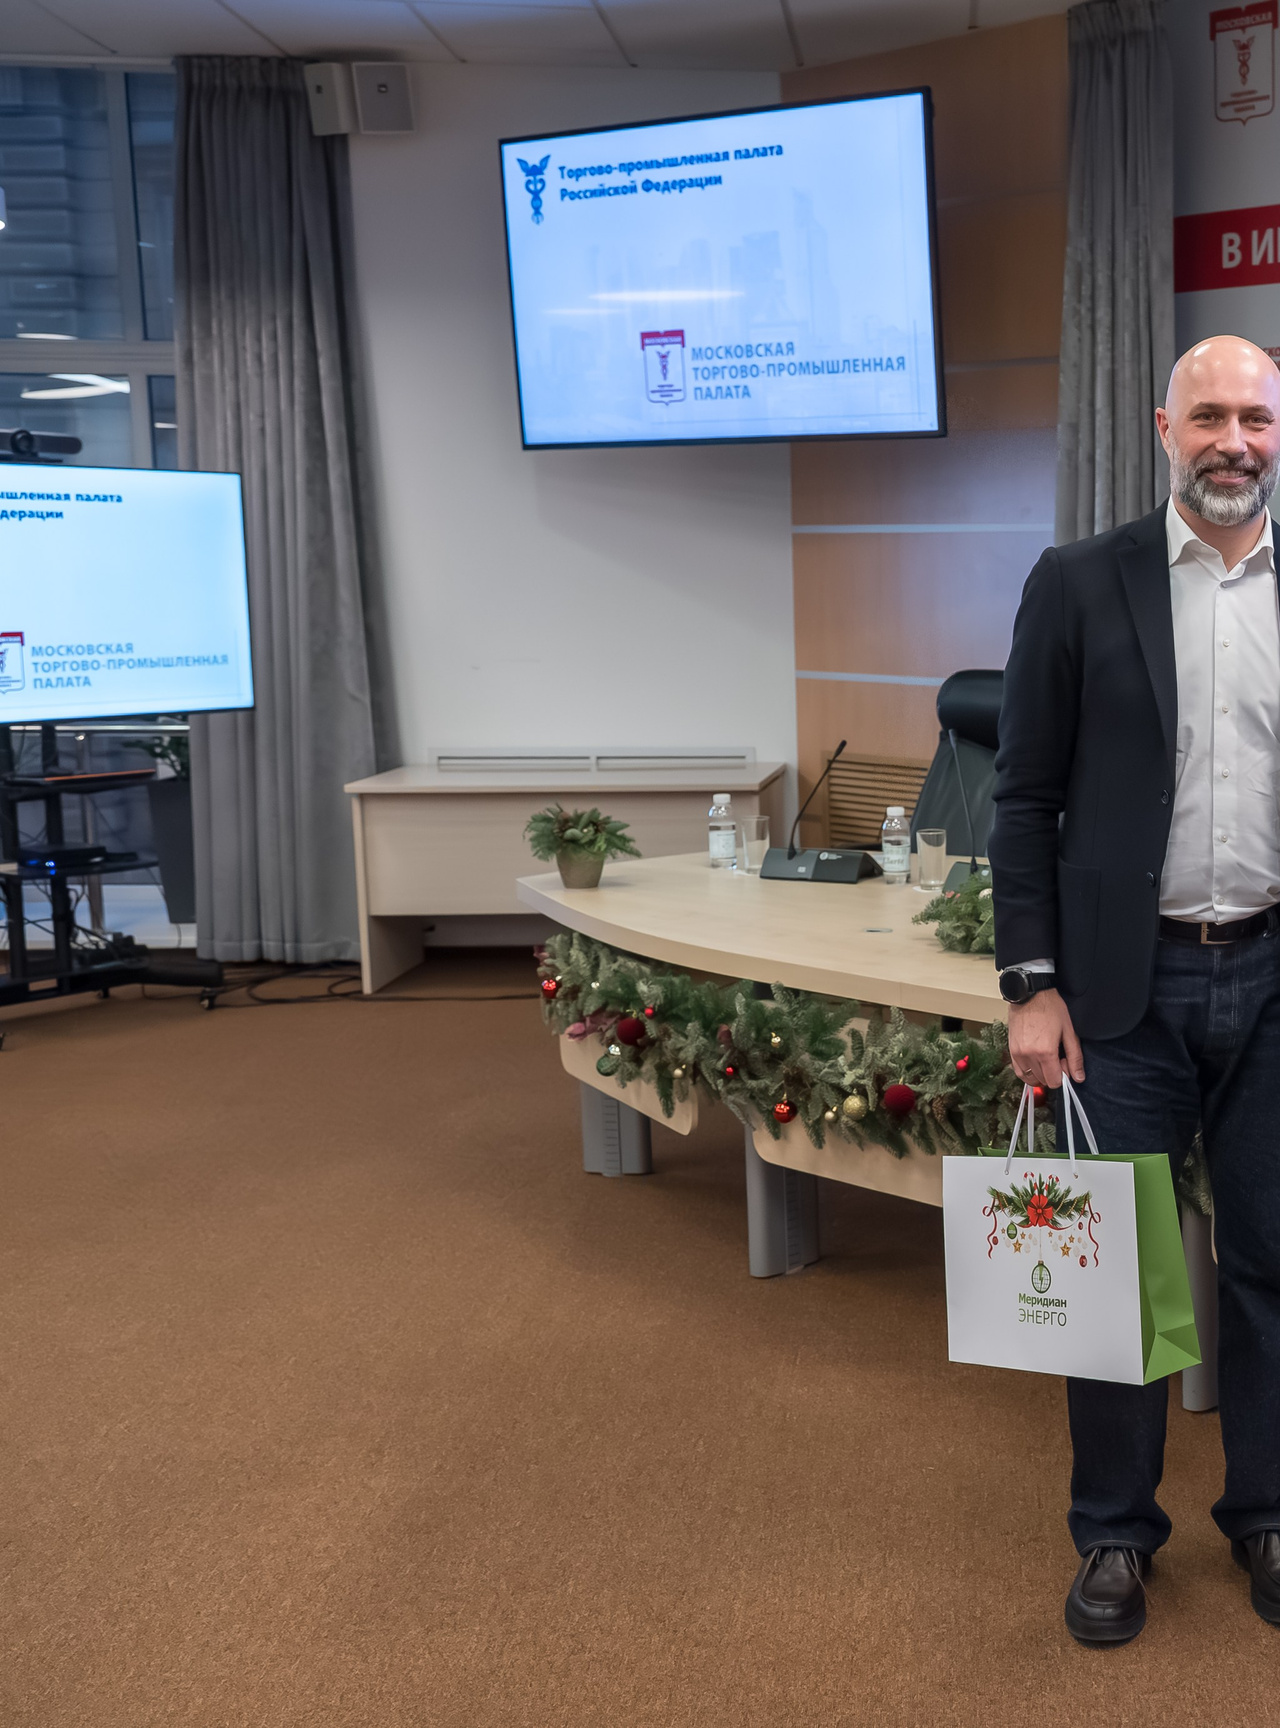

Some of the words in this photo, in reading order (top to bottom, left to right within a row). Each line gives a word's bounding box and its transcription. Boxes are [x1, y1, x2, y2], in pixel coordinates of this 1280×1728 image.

[558, 151, 730, 181] Торгово-промышленная
[734, 144, 783, 160] палата
[560, 181, 637, 201] Российской
[642, 175, 722, 194] Федерации
[1221, 231, 1241, 269] В
[691, 341, 795, 361] МОСКОВСКАЯ
[692, 356, 905, 381] ТОРГОВО-ПРОМЫШЛЕННАЯ
[694, 385, 751, 400] ПАЛАТА
[76, 493, 122, 503] палата
[31, 643, 133, 657] МОСКОВСКАЯ
[32, 655, 228, 673] ТОРГОВО-ПРОМЫШЛЕННАЯ
[33, 676, 91, 689] ПАЛАТА
[1018, 1293, 1067, 1308] Меридиан
[1018, 1308, 1067, 1326] ЭНЕРГО
